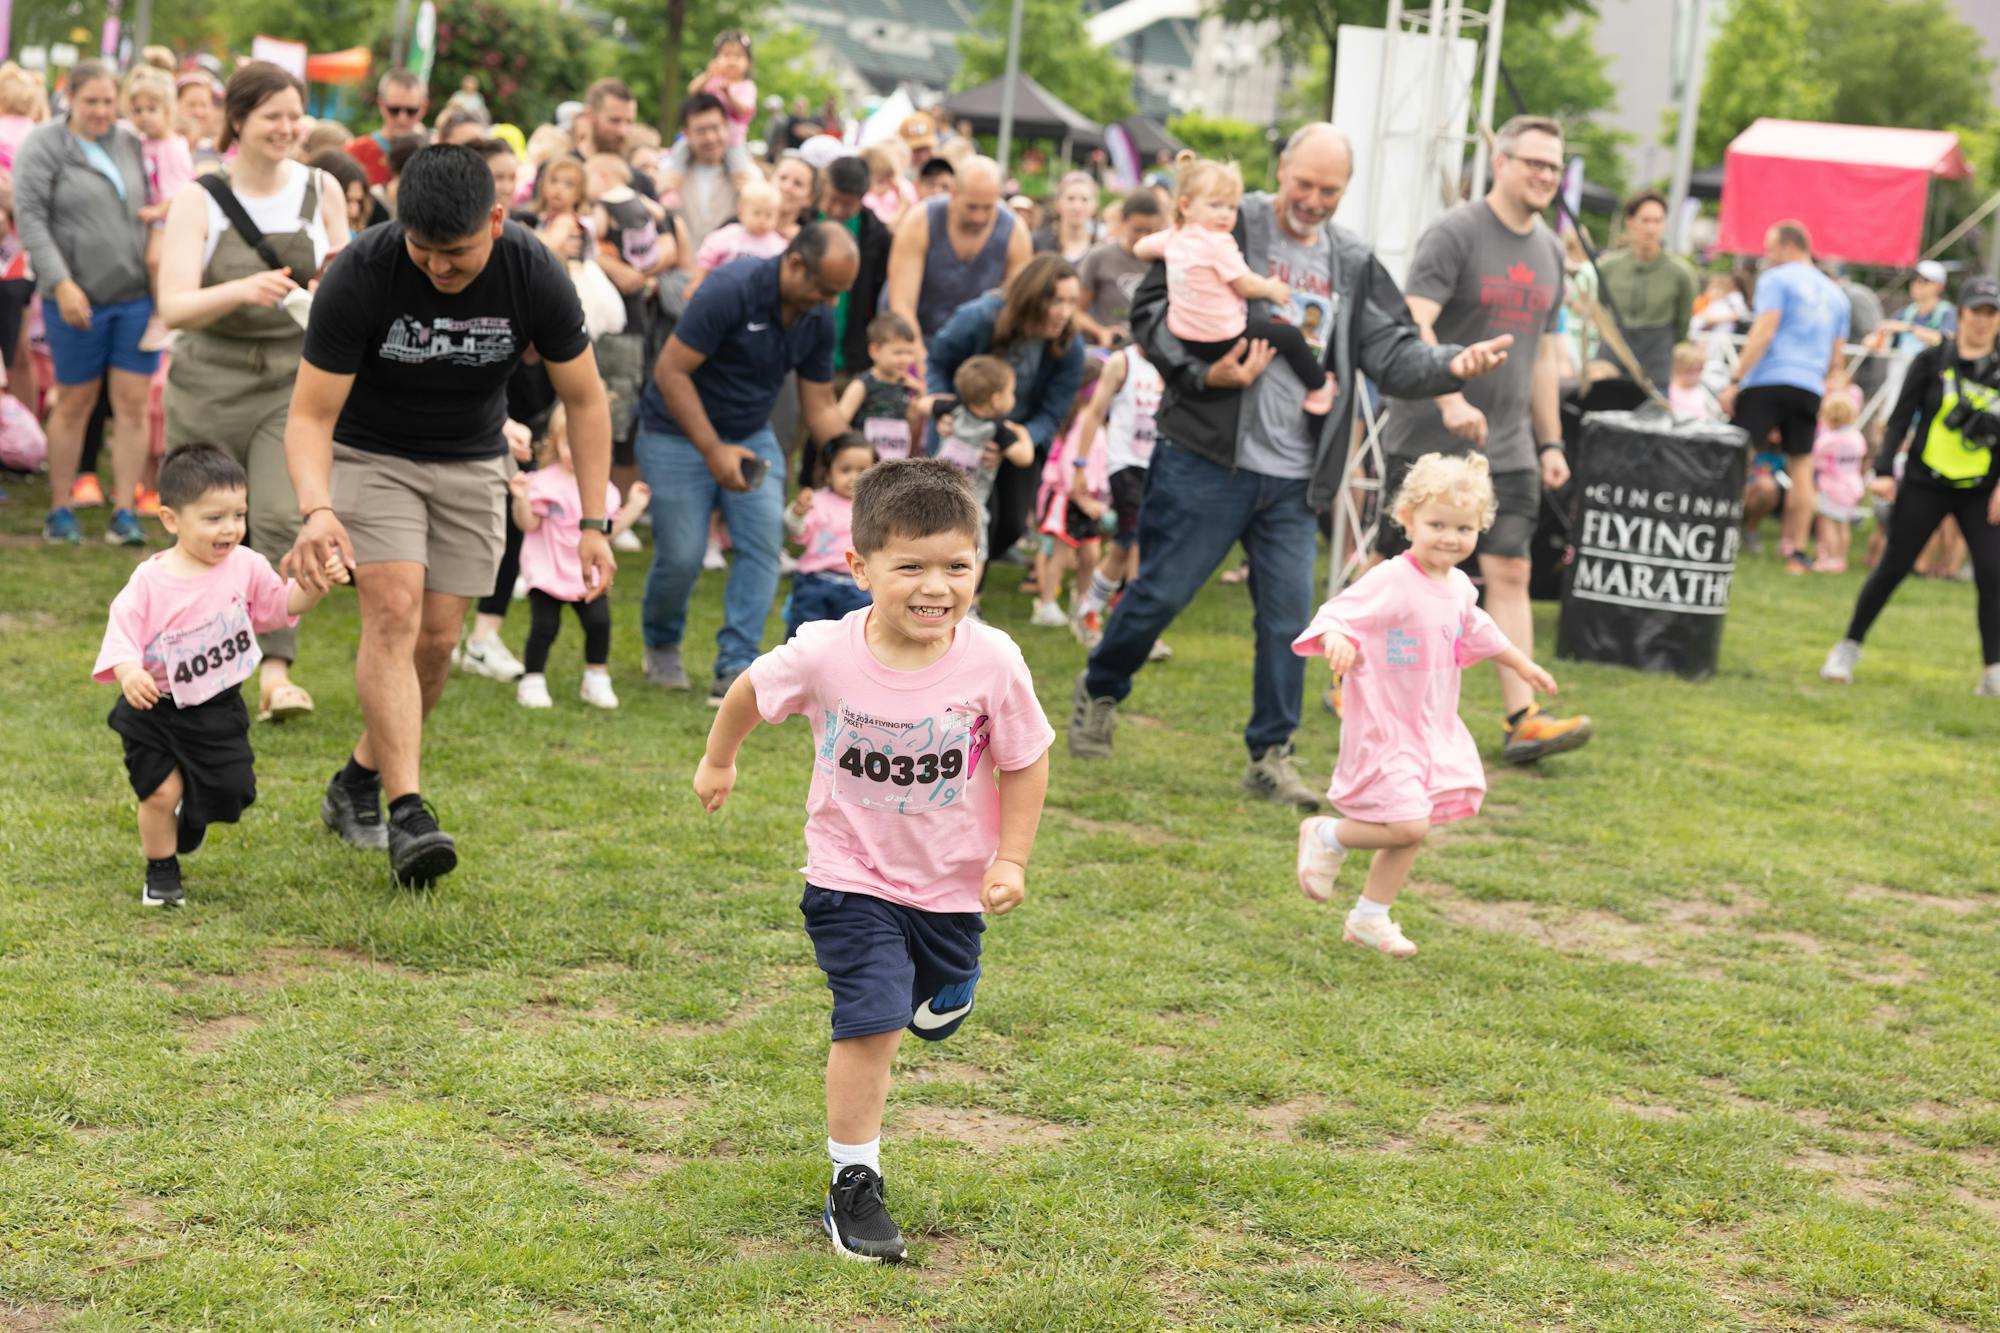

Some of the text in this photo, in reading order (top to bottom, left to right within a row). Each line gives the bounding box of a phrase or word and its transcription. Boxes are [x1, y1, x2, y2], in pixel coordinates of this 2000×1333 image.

[1582, 509, 1716, 562] FLYING
[174, 630, 251, 684] 40338
[843, 716, 863, 729] PIGLET
[845, 709, 855, 720] THE
[856, 714, 874, 725] 2024
[875, 719, 900, 729] FLYING
[839, 747, 963, 787] 40339
